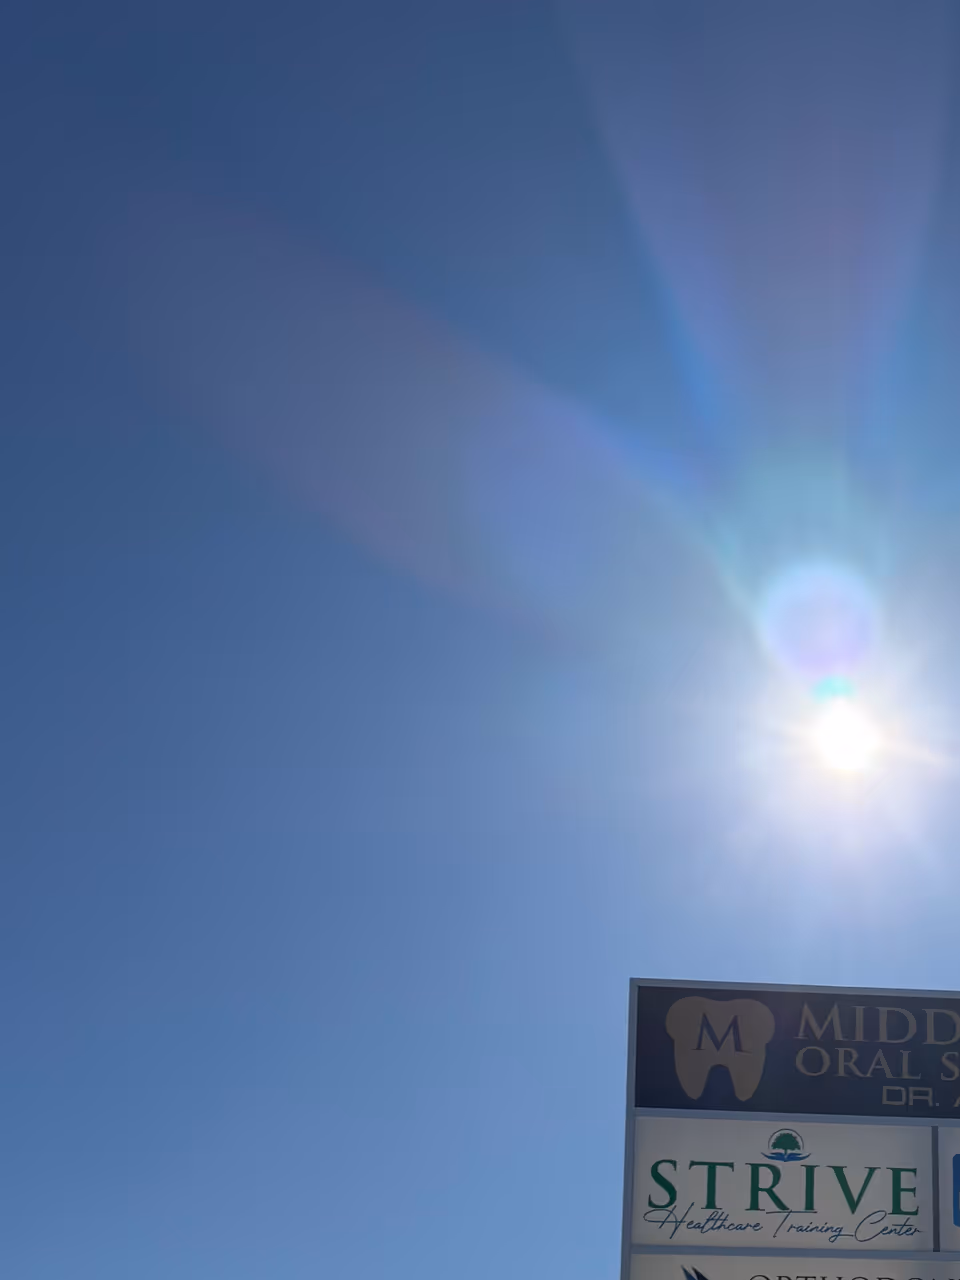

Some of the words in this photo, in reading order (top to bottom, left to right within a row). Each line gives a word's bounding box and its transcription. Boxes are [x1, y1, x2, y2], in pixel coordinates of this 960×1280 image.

[692, 1012, 753, 1056] M
[795, 1045, 922, 1080] ORAL
[881, 1085, 940, 1107] DR.
[647, 1158, 920, 1216] STRIVE
[643, 1202, 764, 1240] Healthcare
[766, 1209, 854, 1243] Training
[854, 1209, 924, 1242] Center
